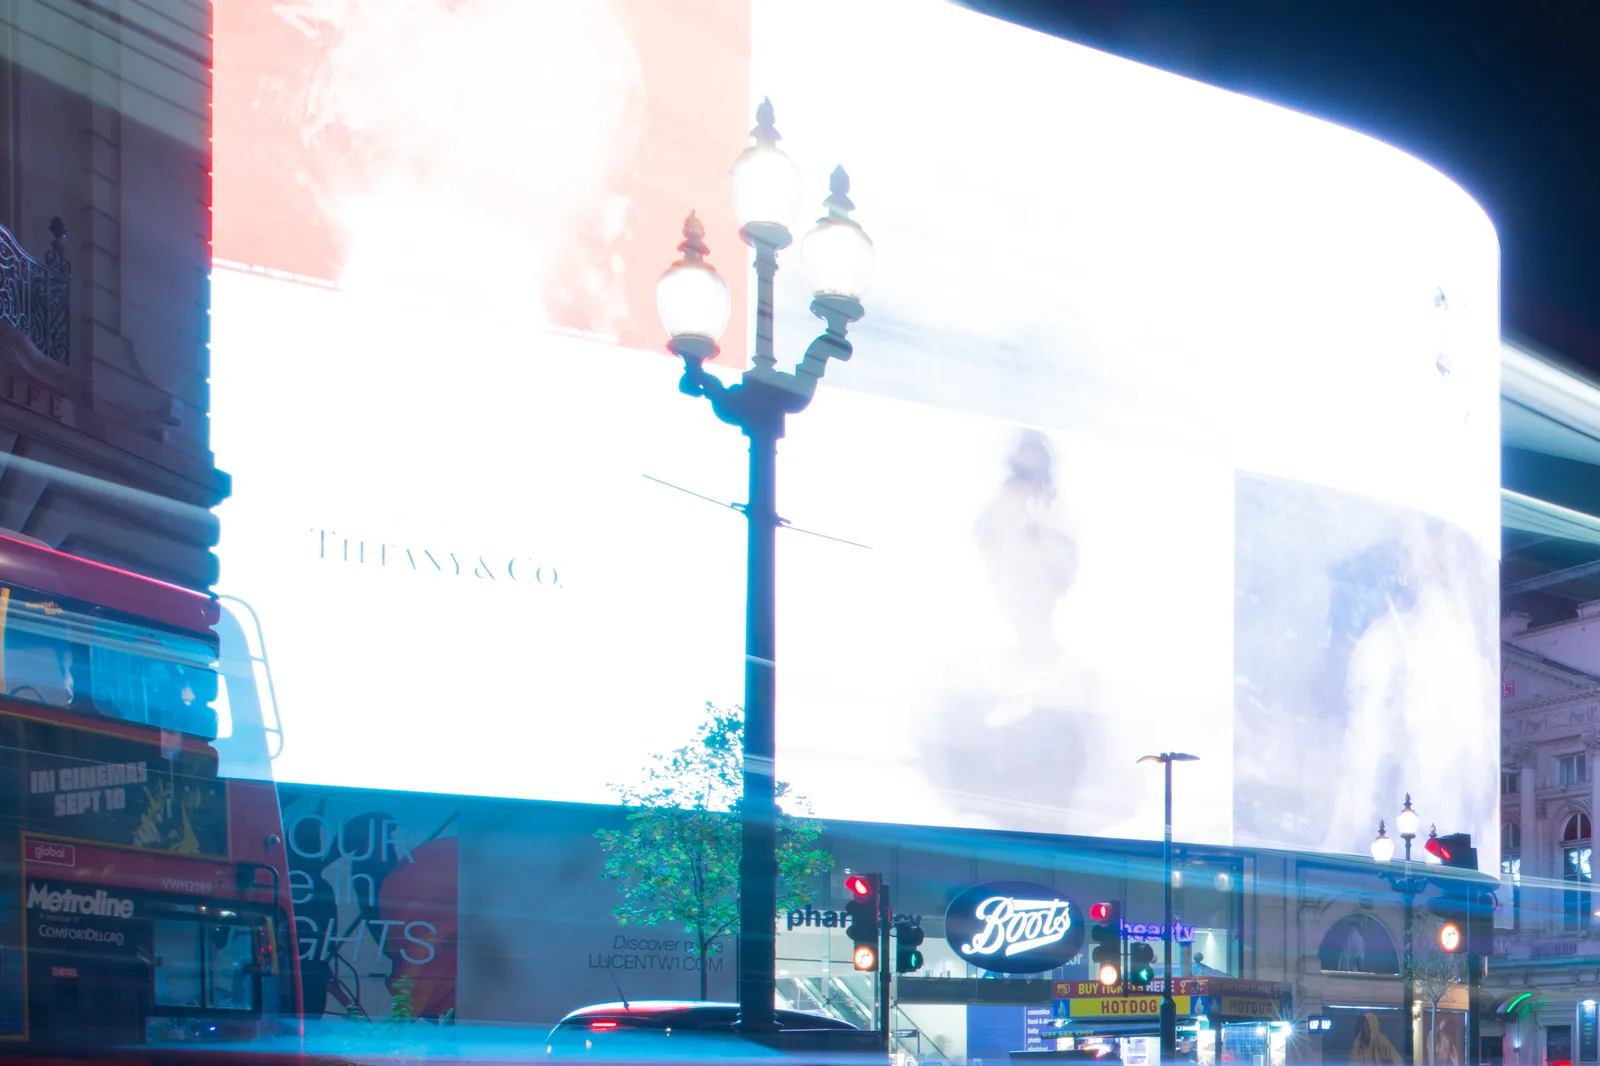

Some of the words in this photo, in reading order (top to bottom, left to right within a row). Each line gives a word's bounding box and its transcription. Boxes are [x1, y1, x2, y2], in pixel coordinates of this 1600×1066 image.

[30, 769, 56, 794] IN
[59, 761, 148, 791] CINEMAS
[54, 790, 101, 817] SEPT
[105, 787, 126, 809] 10
[283, 813, 415, 863] OUR
[34, 845, 66, 859] global
[27, 881, 135, 918] Metroline
[961, 896, 1071, 957] Boots
[612, 935, 681, 951] Discover
[588, 954, 723, 972] LUCENTW1.COM
[1078, 982, 1098, 995] BUY
[1101, 1000, 1158, 1015] HOTDOG
